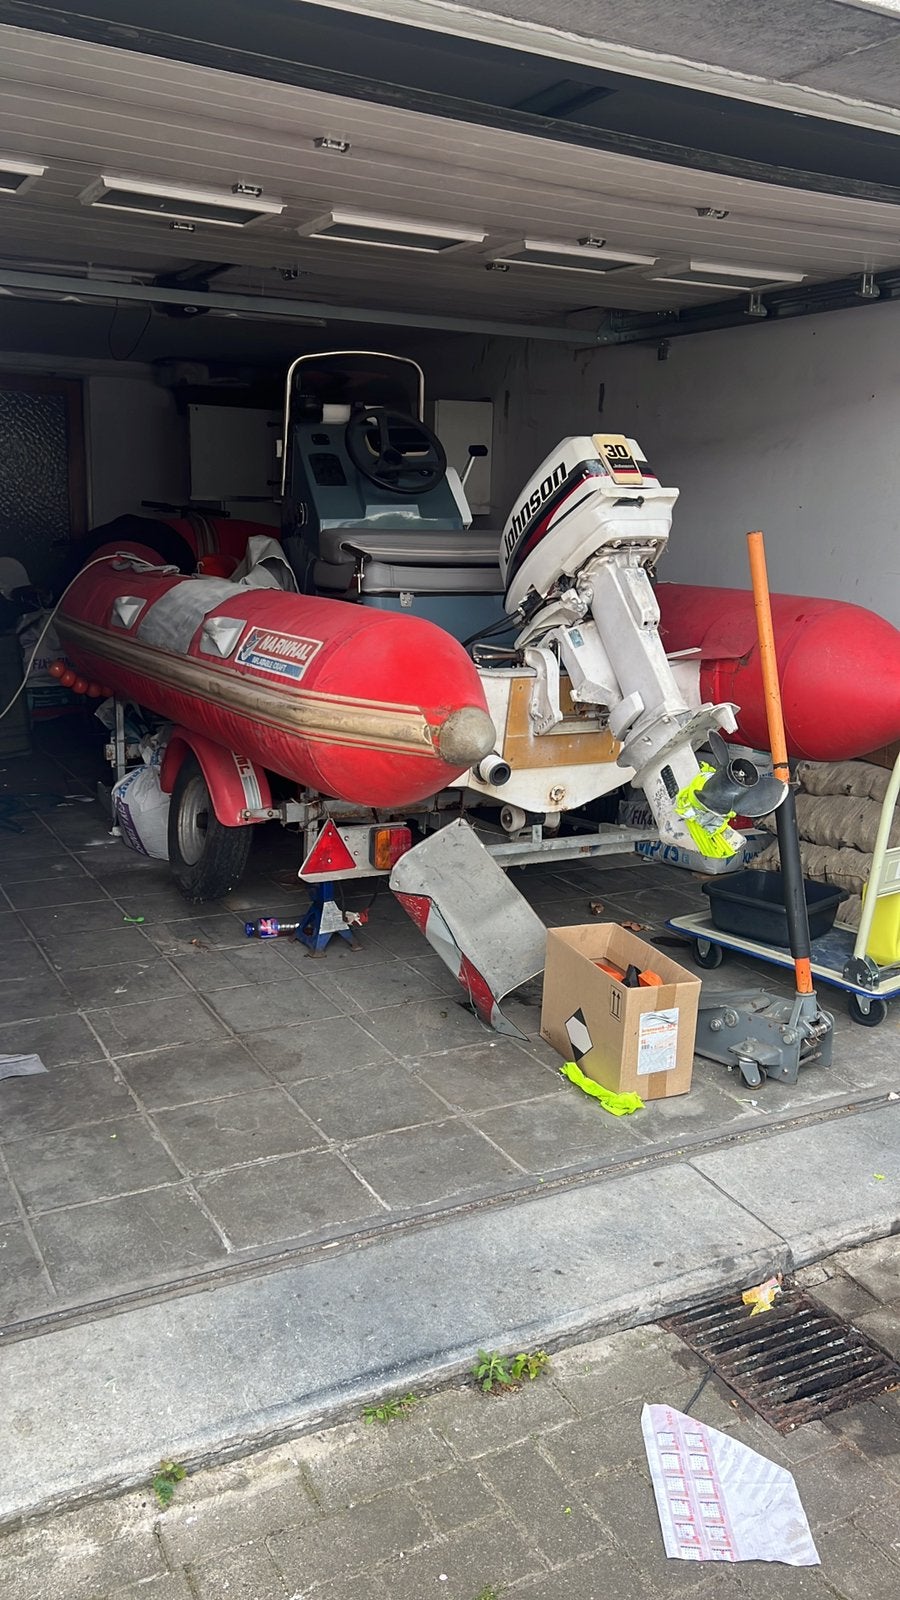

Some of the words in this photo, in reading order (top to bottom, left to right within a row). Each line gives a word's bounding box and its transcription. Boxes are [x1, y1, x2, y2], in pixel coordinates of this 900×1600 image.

[603, 444, 629, 458] 30
[504, 461, 568, 565] Johnson
[258, 635, 313, 660] NARWHAL
